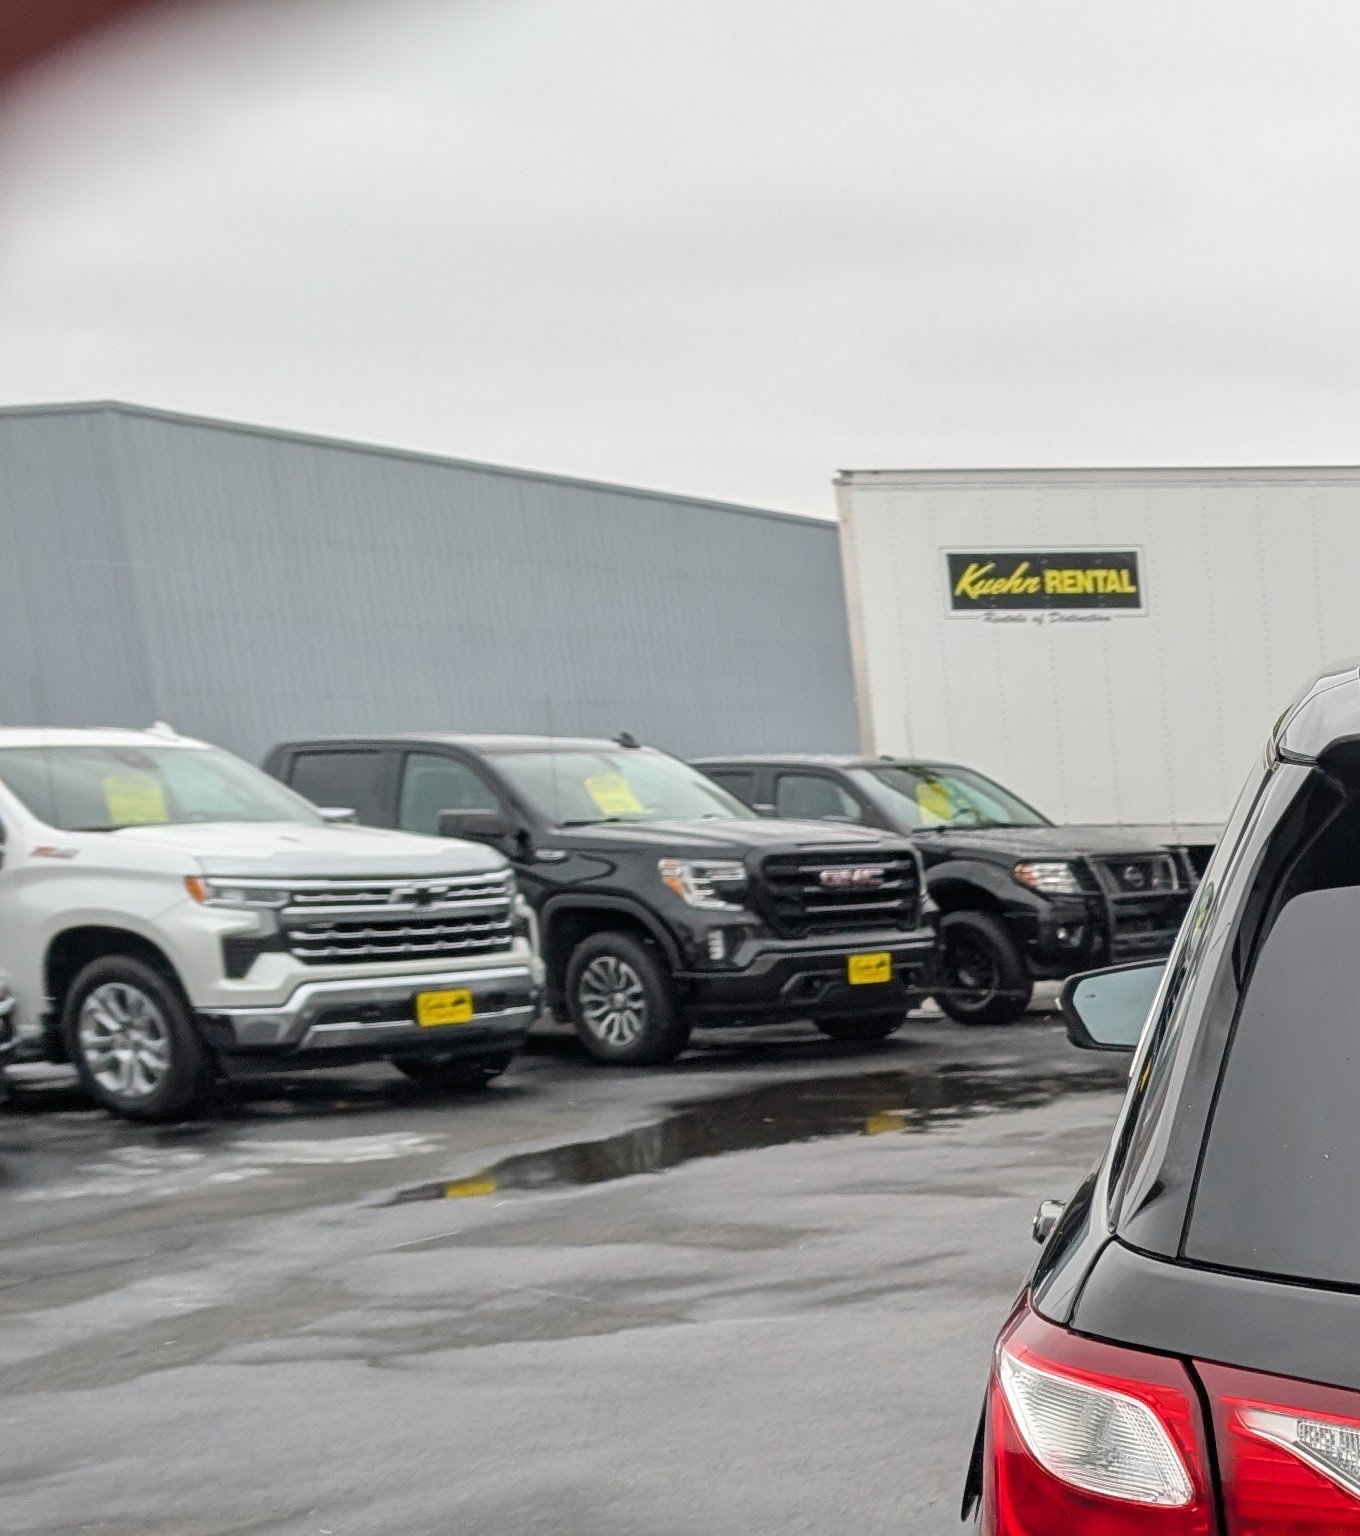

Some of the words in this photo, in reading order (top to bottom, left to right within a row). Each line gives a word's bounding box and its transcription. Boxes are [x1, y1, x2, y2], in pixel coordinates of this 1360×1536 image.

[955, 561, 1041, 600] Kuehn
[1043, 568, 1137, 594] RENTAL
[820, 868, 885, 888] GMC
